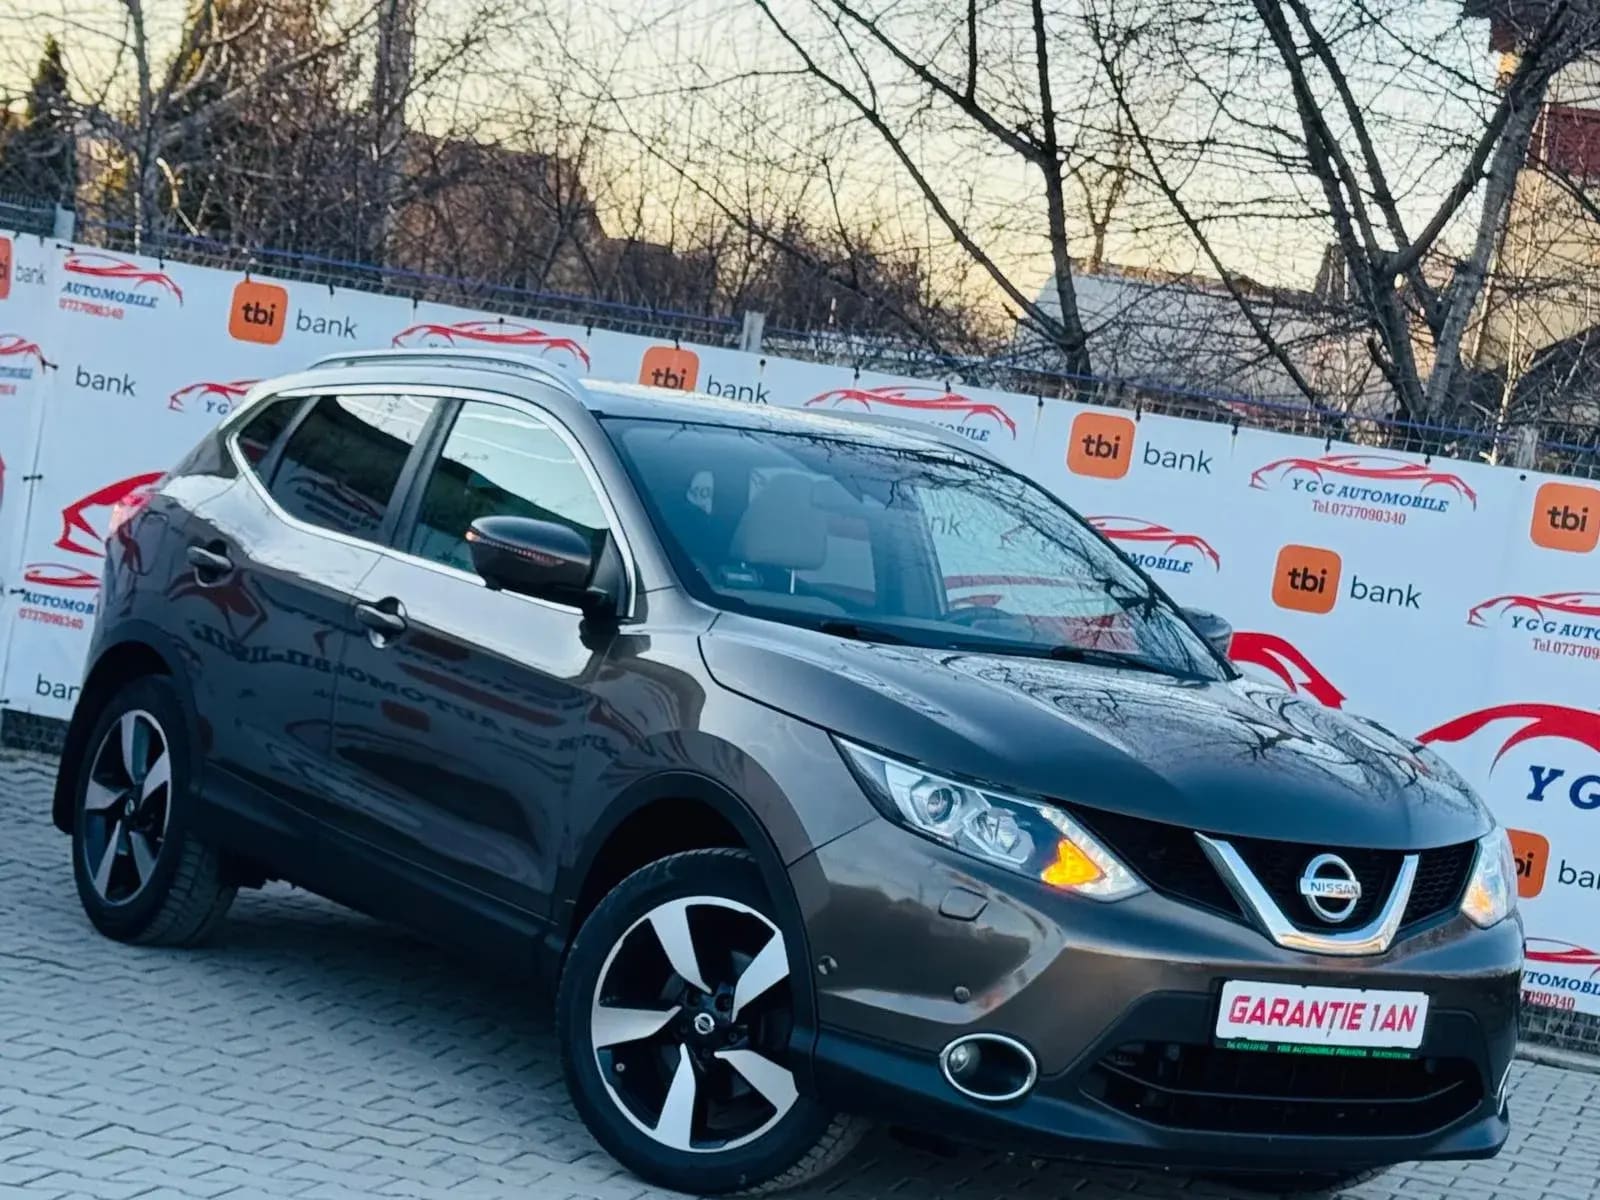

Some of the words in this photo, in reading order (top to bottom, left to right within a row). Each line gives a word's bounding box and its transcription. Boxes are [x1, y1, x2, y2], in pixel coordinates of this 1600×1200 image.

[61, 281, 159, 309] AUTOMOBILE
[243, 302, 277, 327] tbi
[296, 309, 358, 341] bank
[75, 364, 137, 397] bank
[652, 367, 687, 390] tbi
[706, 373, 770, 405] bank
[1082, 433, 1121, 460] tbi
[1143, 441, 1213, 475] bank
[1337, 485, 1449, 513] AUTOMOBILE
[1547, 505, 1590, 532] tbi
[1287, 567, 1328, 594] tbi
[1350, 575, 1423, 609] bank
[1309, 881, 1360, 896] NISSAN
